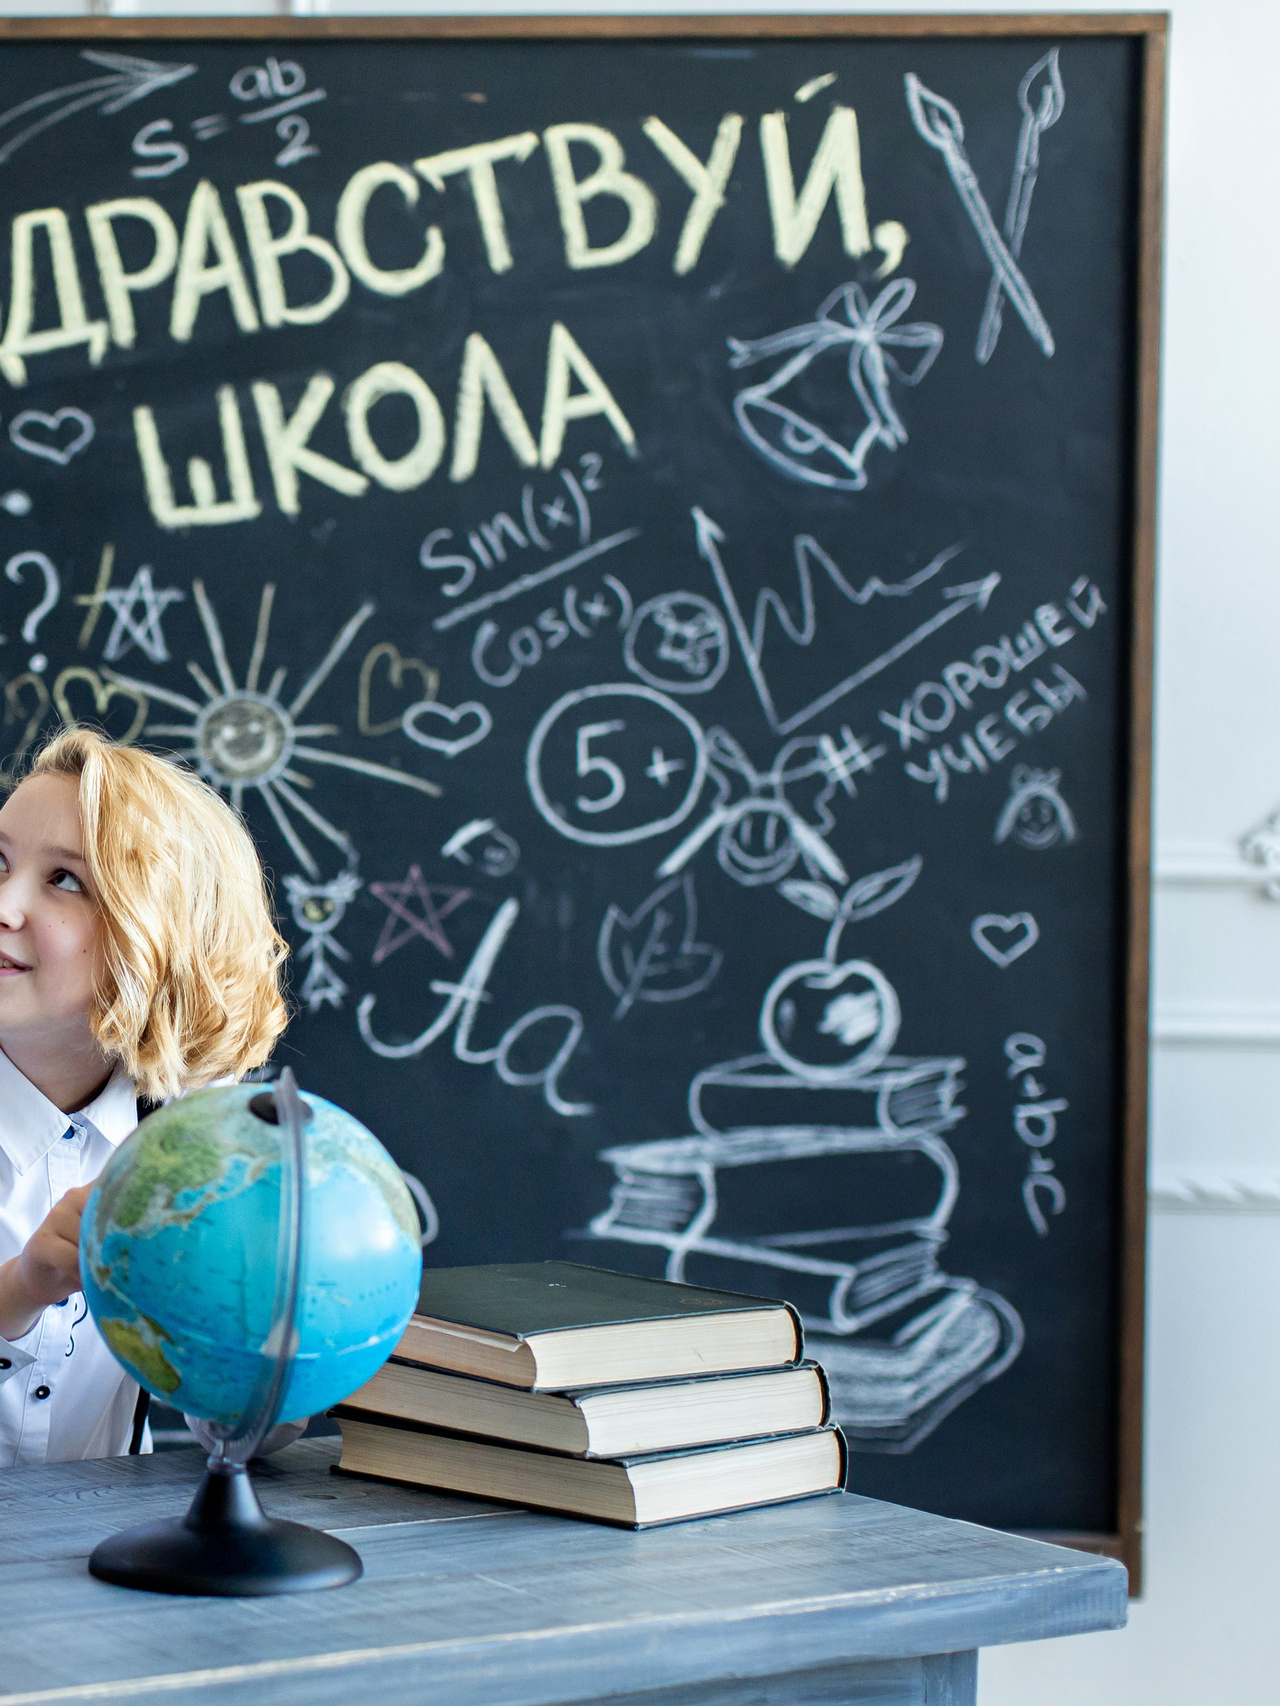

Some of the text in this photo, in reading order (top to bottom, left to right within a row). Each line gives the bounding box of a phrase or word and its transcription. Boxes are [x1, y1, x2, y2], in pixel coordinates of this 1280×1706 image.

[133, 322, 638, 529] ШКОЛА
[576, 718, 685, 813] 5+
[904, 663, 1088, 803] УЧЕБЫ
